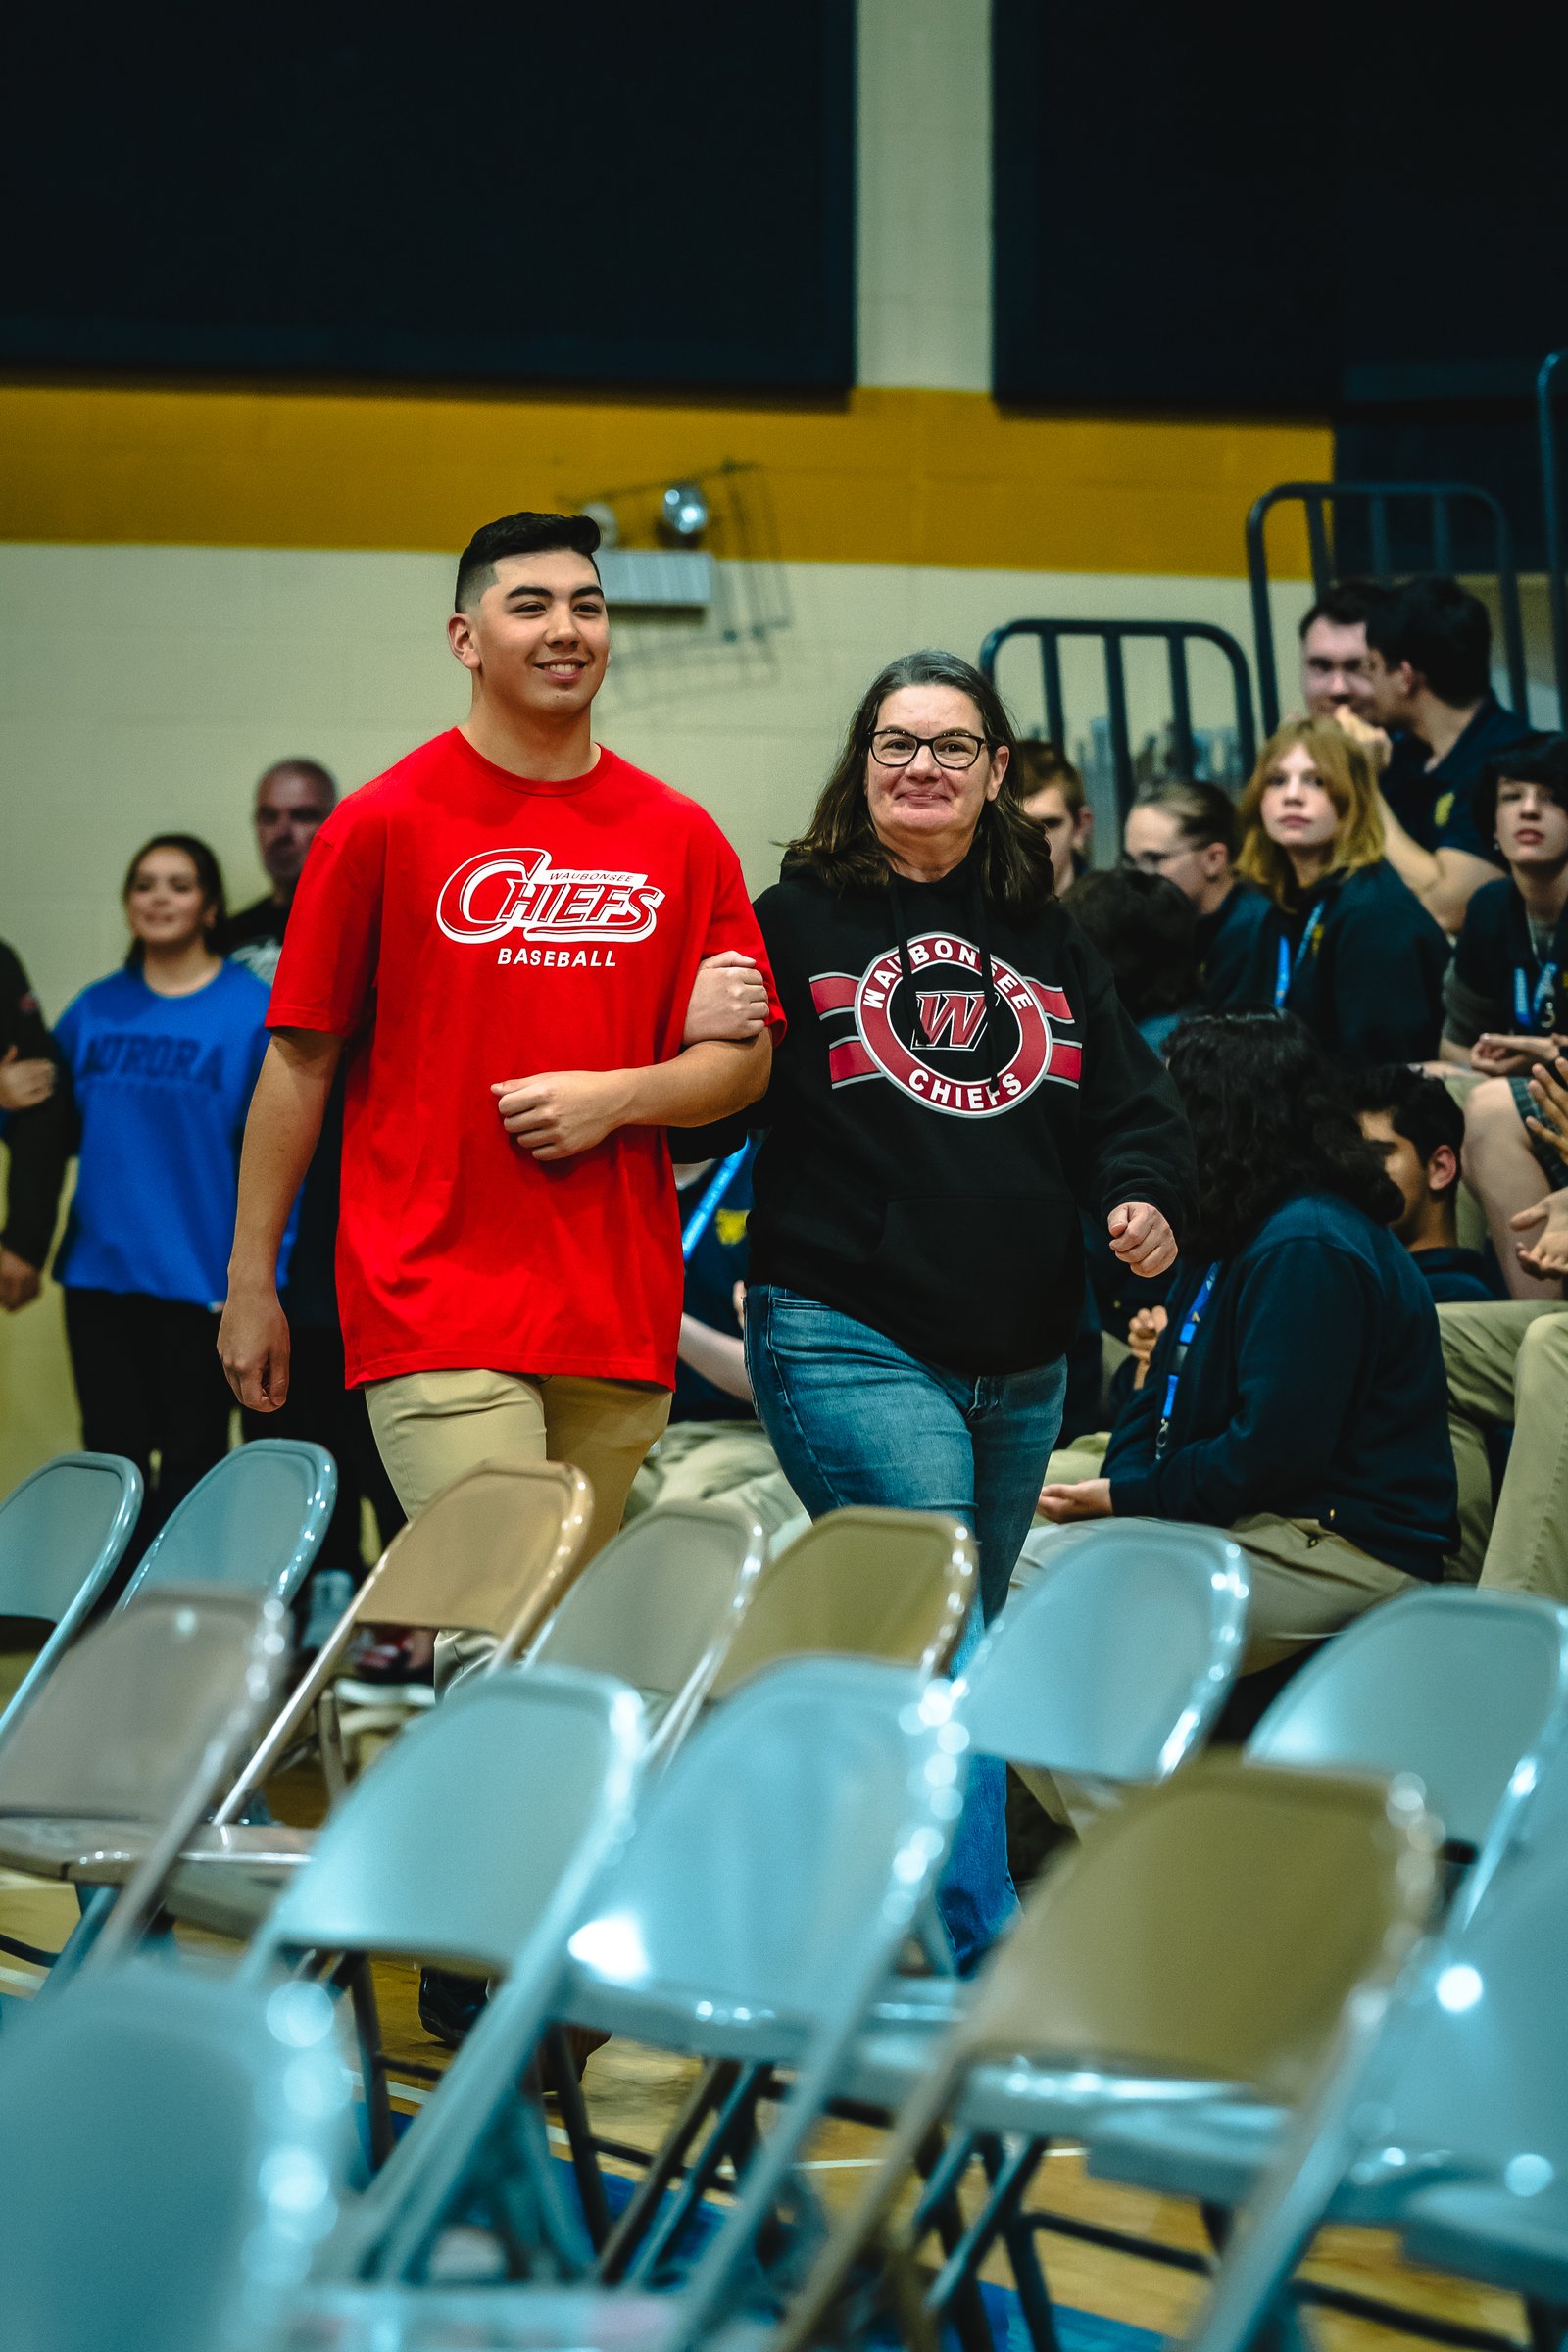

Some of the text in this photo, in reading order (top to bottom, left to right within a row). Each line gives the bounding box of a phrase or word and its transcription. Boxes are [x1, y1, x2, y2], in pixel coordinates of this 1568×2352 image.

[436, 848, 665, 944] CHIEFS
[549, 872, 634, 882] WAUBONSEE
[497, 948, 616, 967] BASEBALL
[912, 991, 990, 1050] W
[78, 1034, 223, 1092] AURORA
[909, 1069, 1022, 1109] CHIEFS
